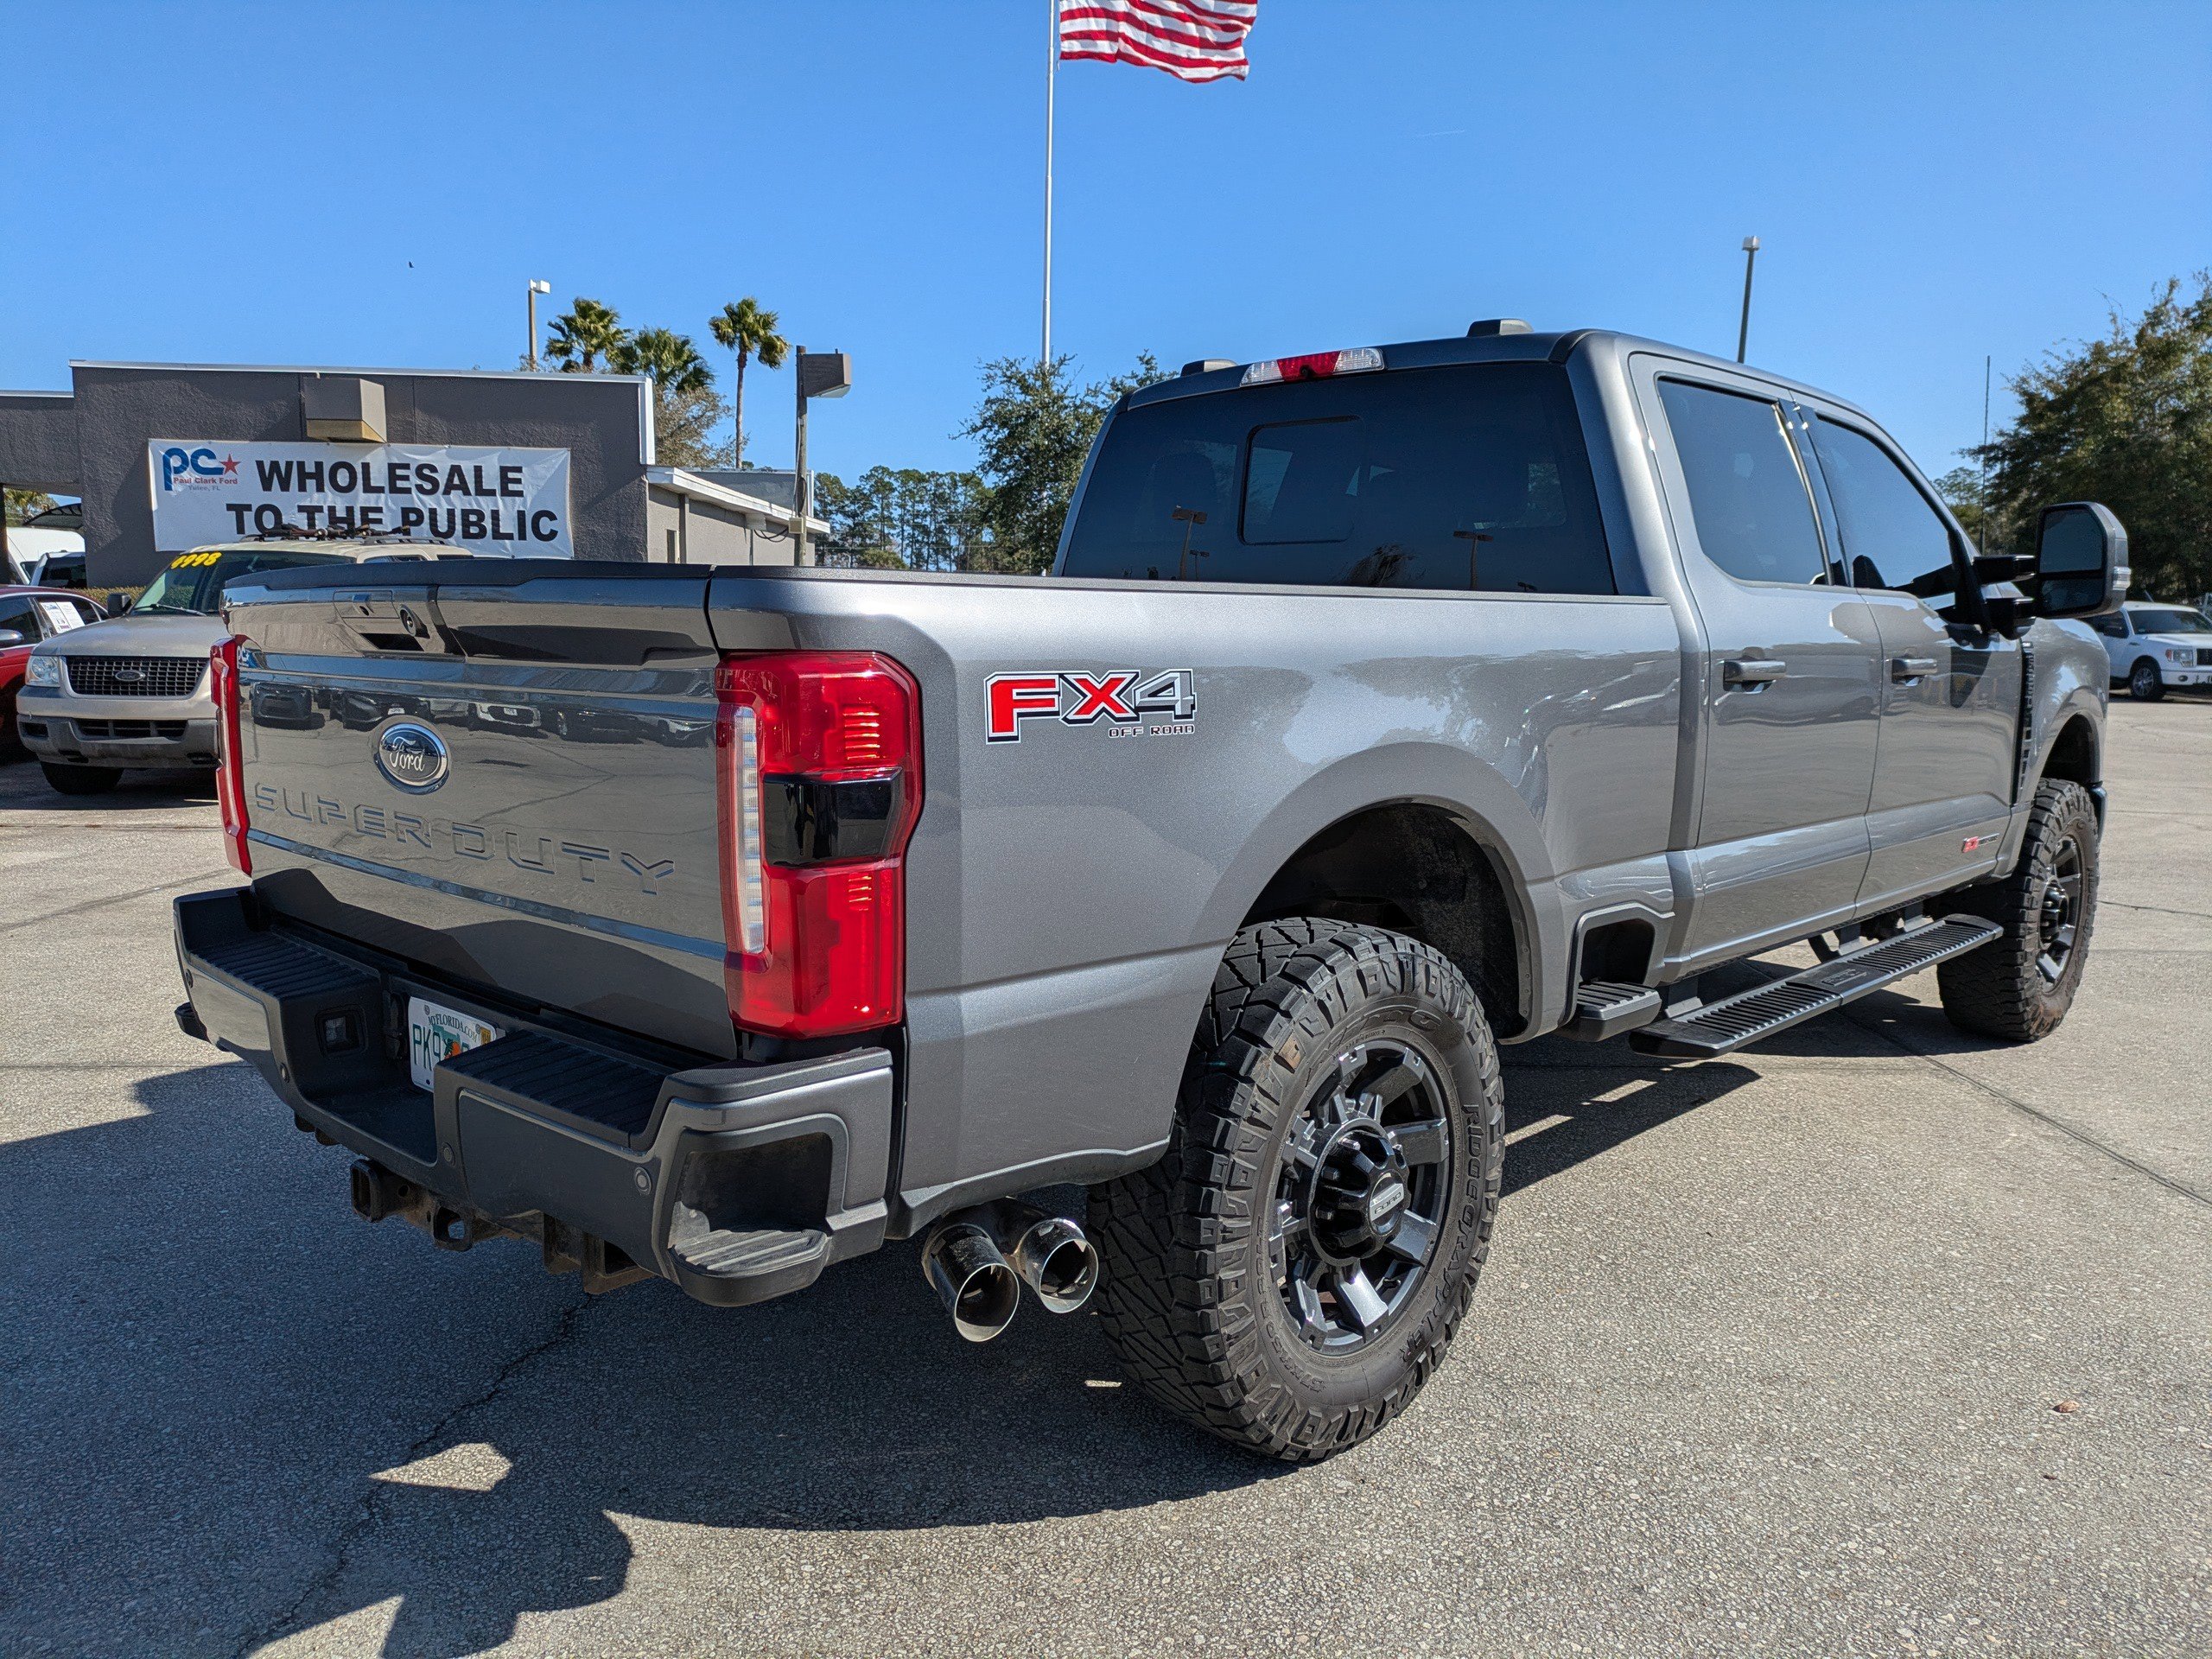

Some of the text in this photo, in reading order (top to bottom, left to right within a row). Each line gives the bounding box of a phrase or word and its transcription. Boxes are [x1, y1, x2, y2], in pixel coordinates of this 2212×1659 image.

[256, 460, 524, 499] WHOLESALE
[226, 503, 559, 543] TO THE PUBLIC
[983, 669, 1198, 746] FX4
[1109, 723, 1195, 739] OFF ROAD
[389, 736, 425, 772] Ford
[256, 781, 675, 896] SUPER DUTY
[1460, 1104, 1484, 1201] RIDGE
[1374, 1192, 1402, 1215] FORD
